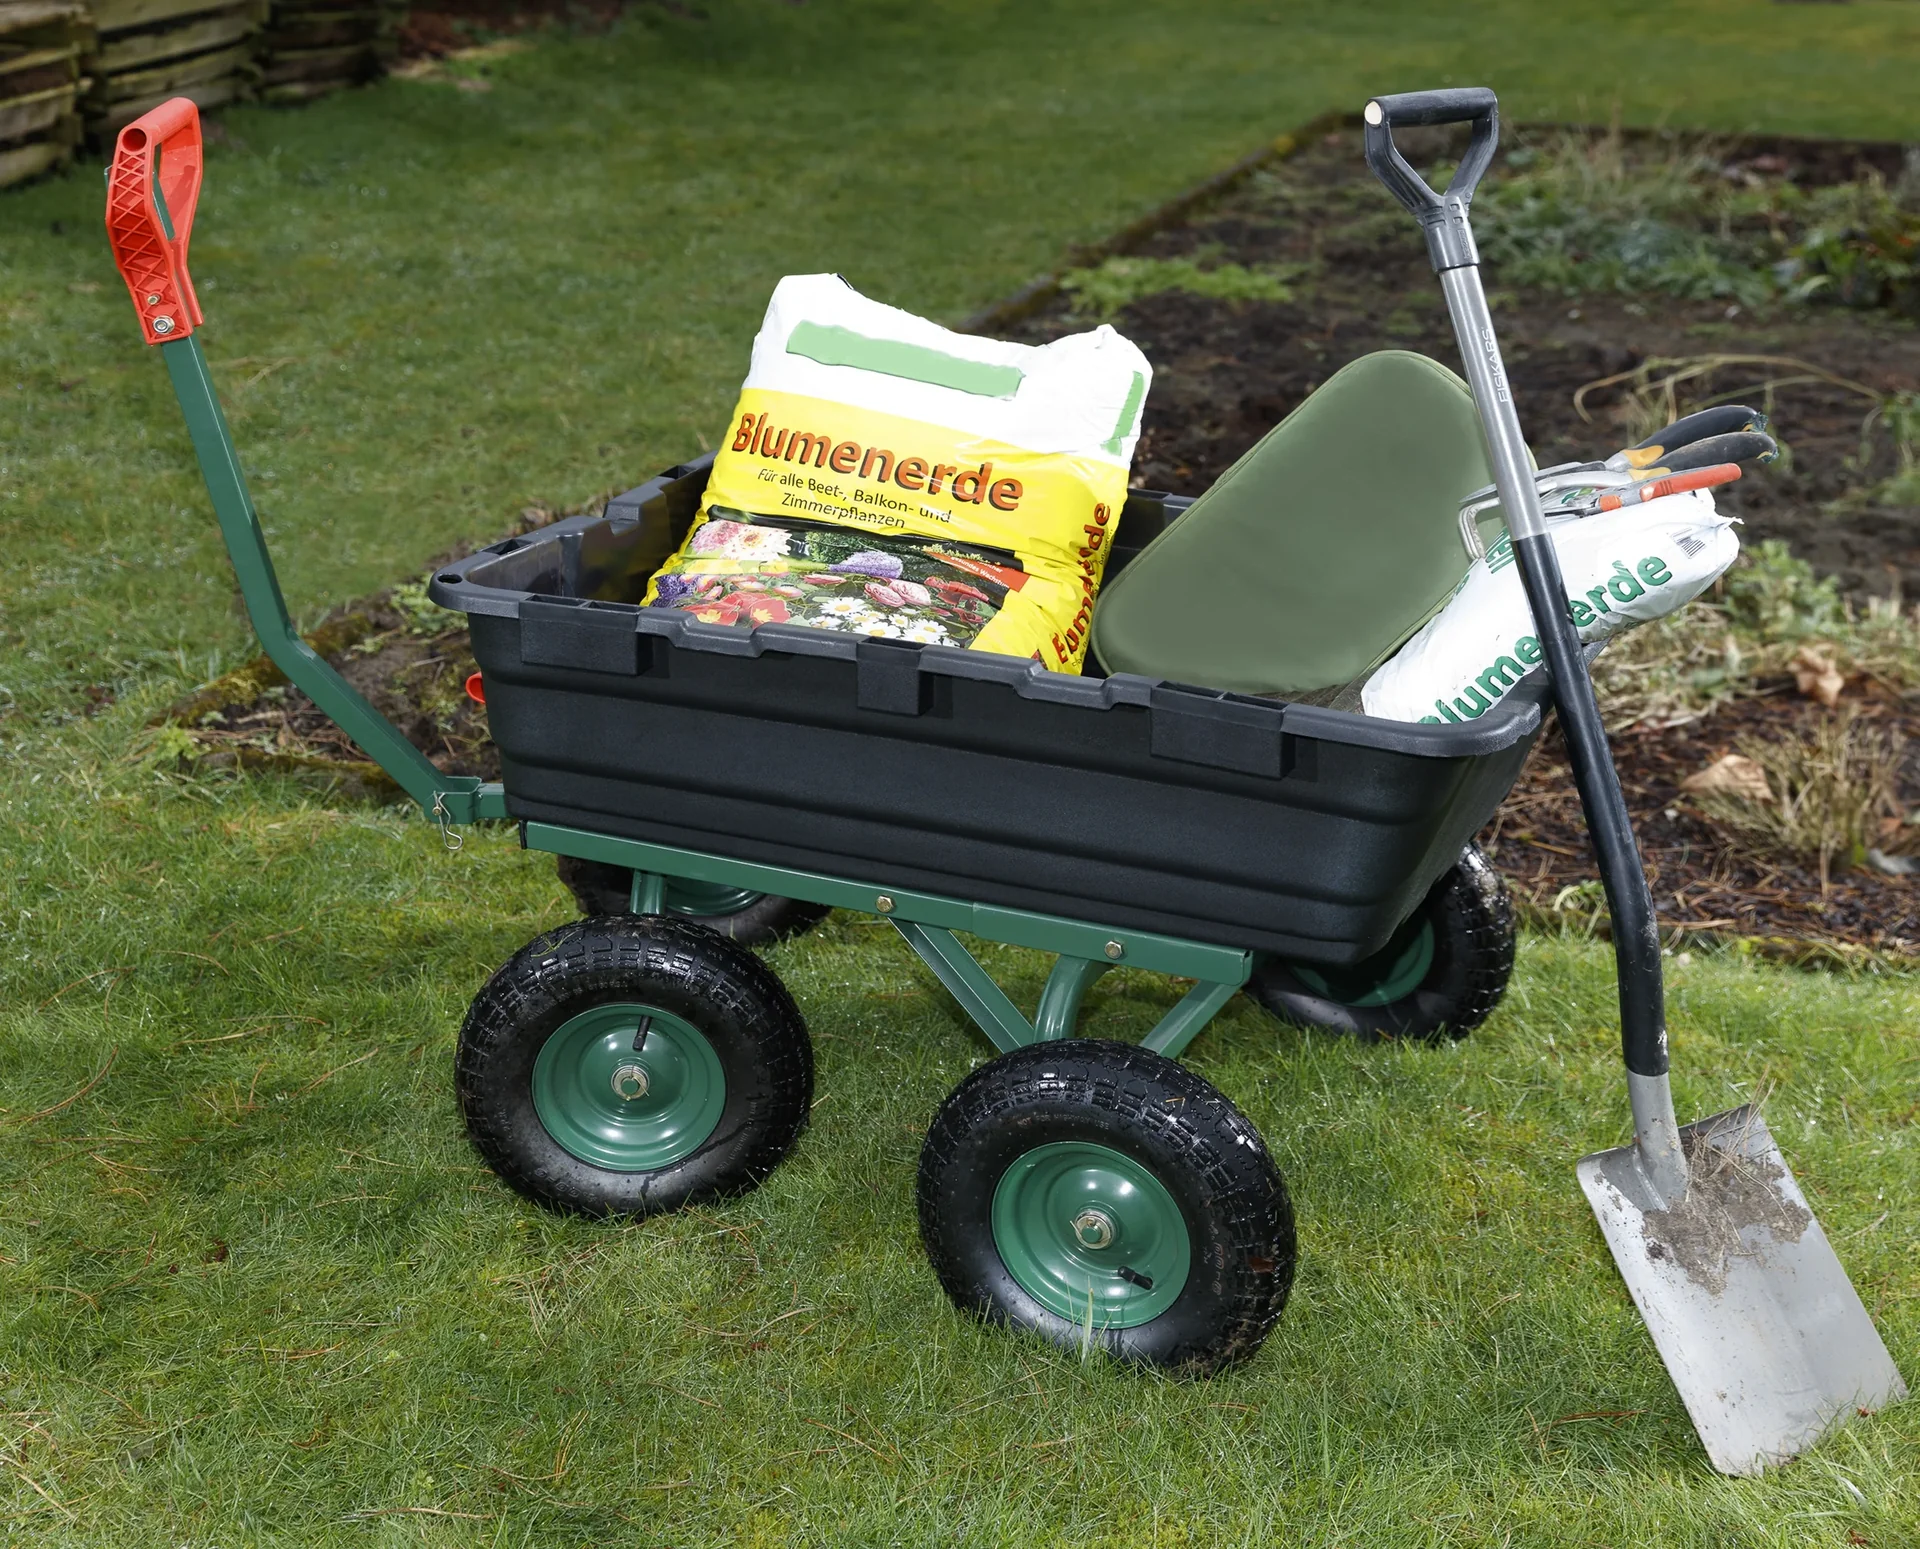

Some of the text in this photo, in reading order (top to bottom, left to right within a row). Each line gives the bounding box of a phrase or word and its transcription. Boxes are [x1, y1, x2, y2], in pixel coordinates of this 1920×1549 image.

[1481, 328, 1511, 402] FISKARS
[732, 412, 1024, 511] Blumenerde
[757, 468, 952, 523] Für alle Beet-, Balkon- und
[781, 492, 905, 529] Zimmerpflanzen
[951, 556, 980, 573] gesundes
